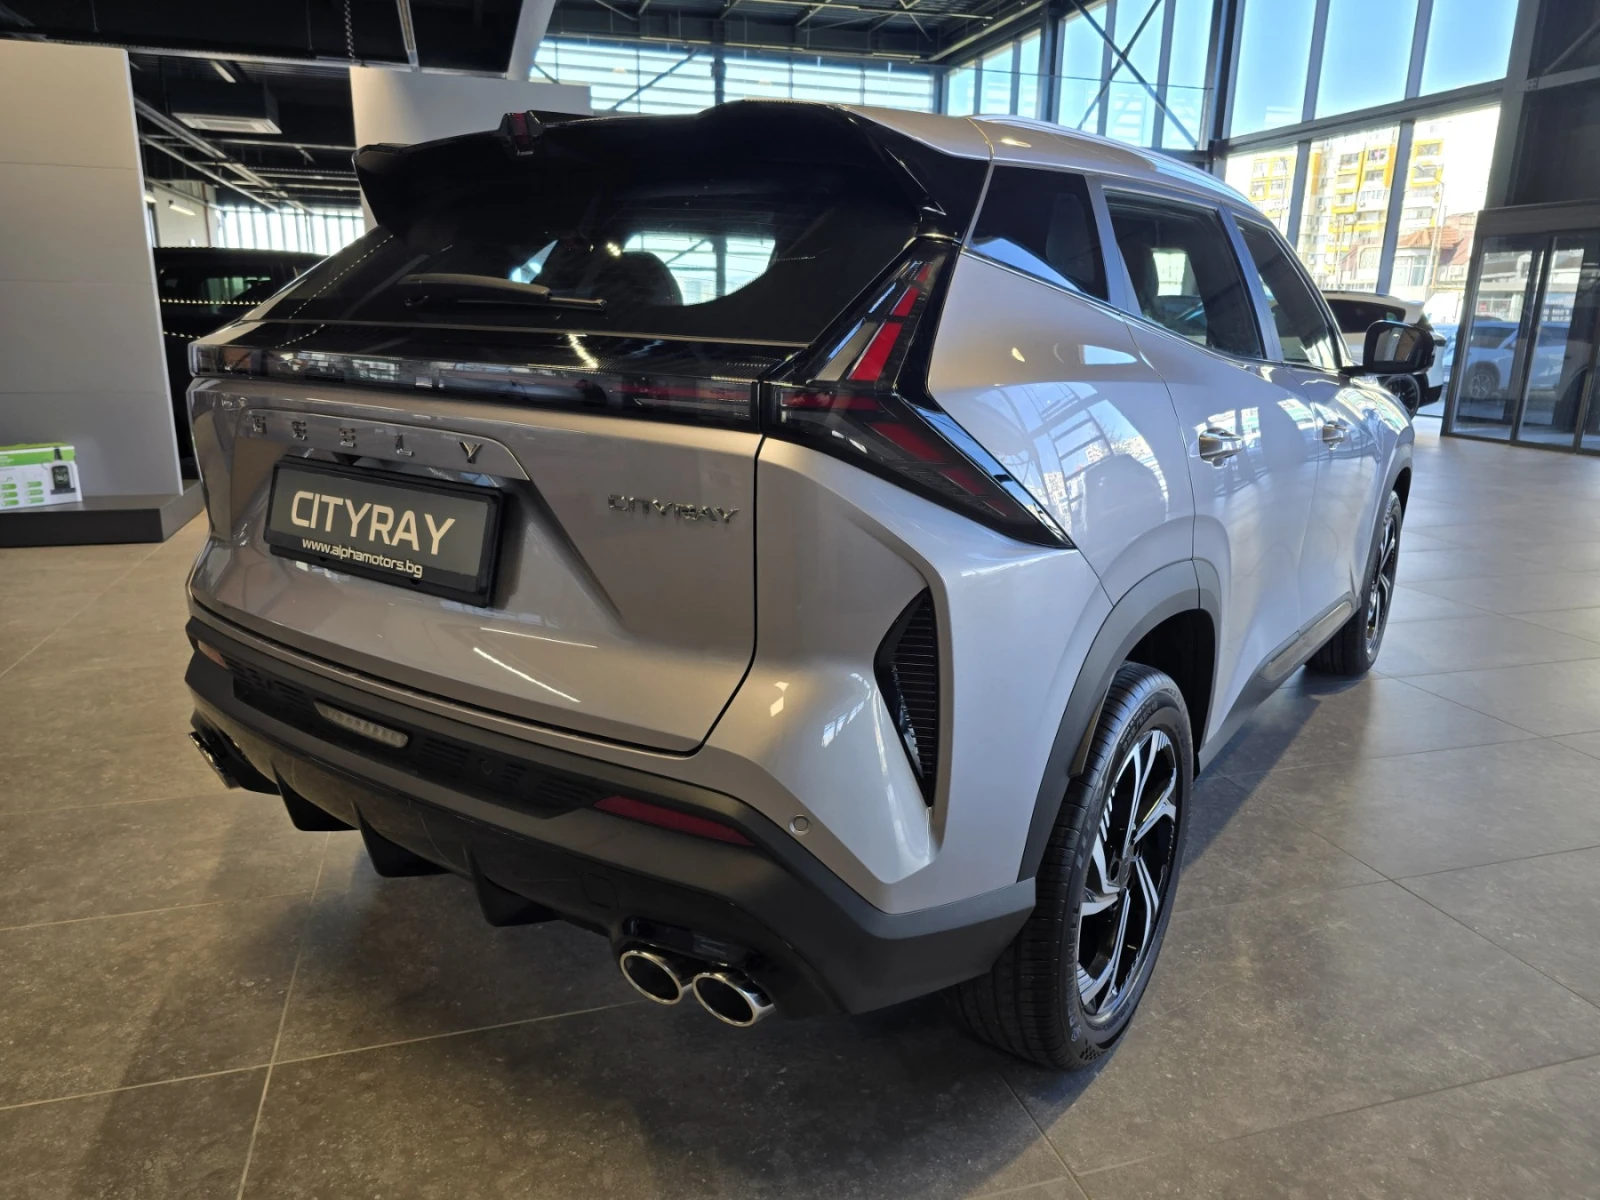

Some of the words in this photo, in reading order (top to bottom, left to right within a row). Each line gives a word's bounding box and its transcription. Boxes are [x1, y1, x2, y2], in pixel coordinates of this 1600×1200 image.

[291, 490, 455, 555] CITYRAY
[608, 494, 739, 524] CITYRAY
[302, 538, 423, 578] www.alphamotors.bg
